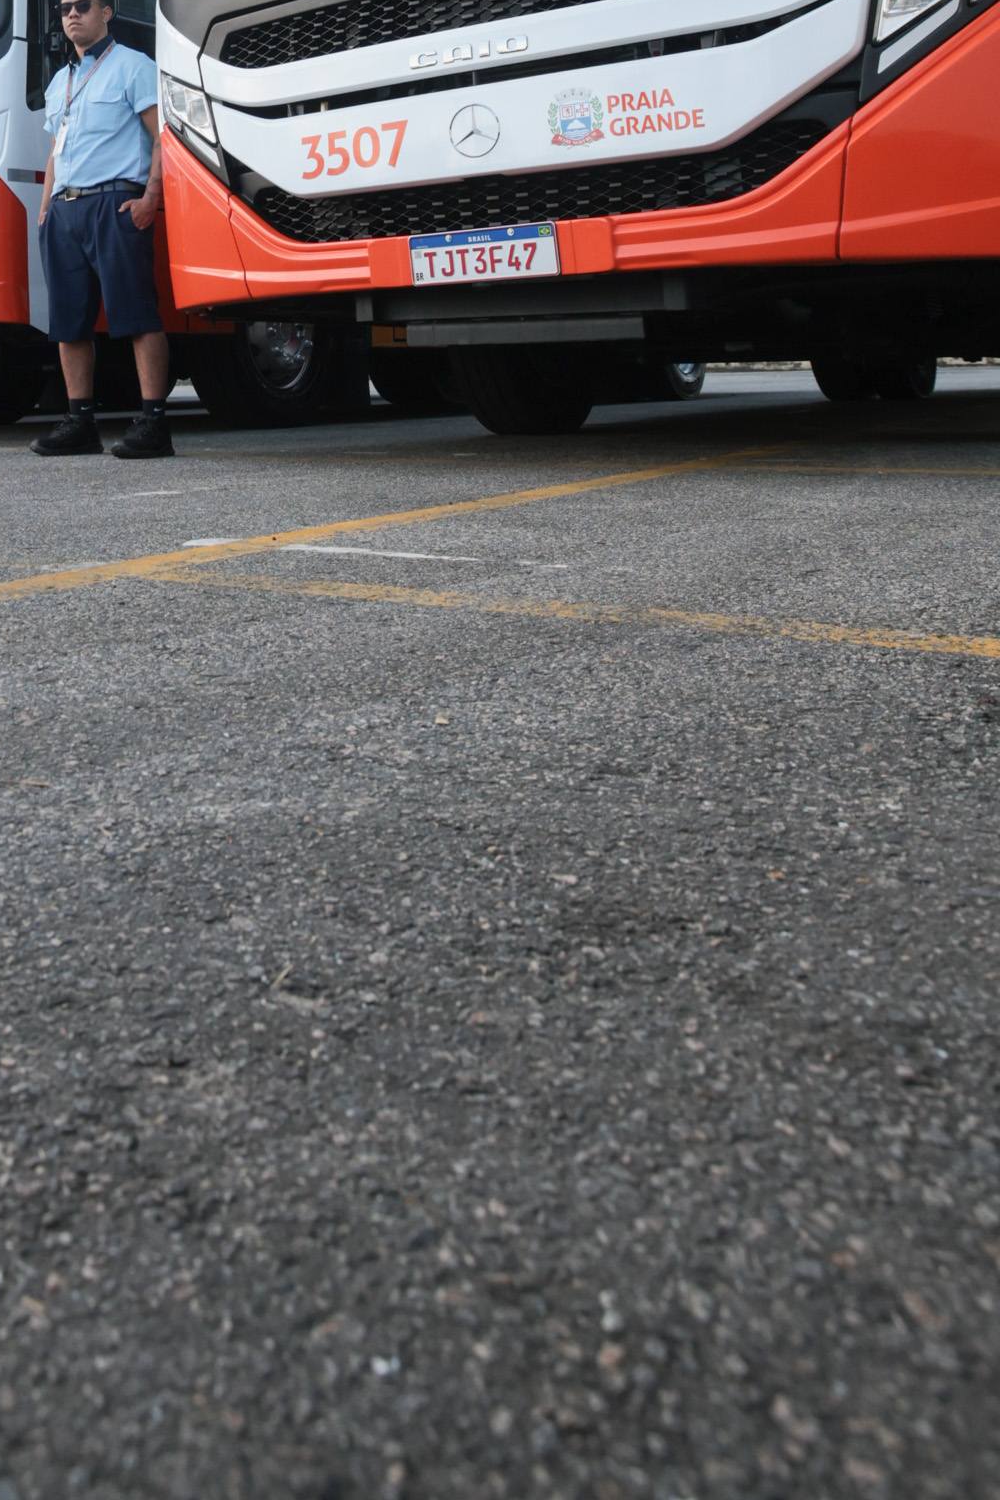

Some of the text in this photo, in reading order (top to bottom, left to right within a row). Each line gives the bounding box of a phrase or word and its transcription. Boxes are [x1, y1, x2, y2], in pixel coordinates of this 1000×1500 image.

[408, 34, 529, 70] CAIO
[606, 88, 676, 115] PRAIA
[609, 108, 706, 137] GRANDE
[300, 119, 409, 180] 3507
[467, 234, 492, 243] BRASIL
[423, 242, 538, 279] TJT3F47
[415, 272, 425, 282] BR
